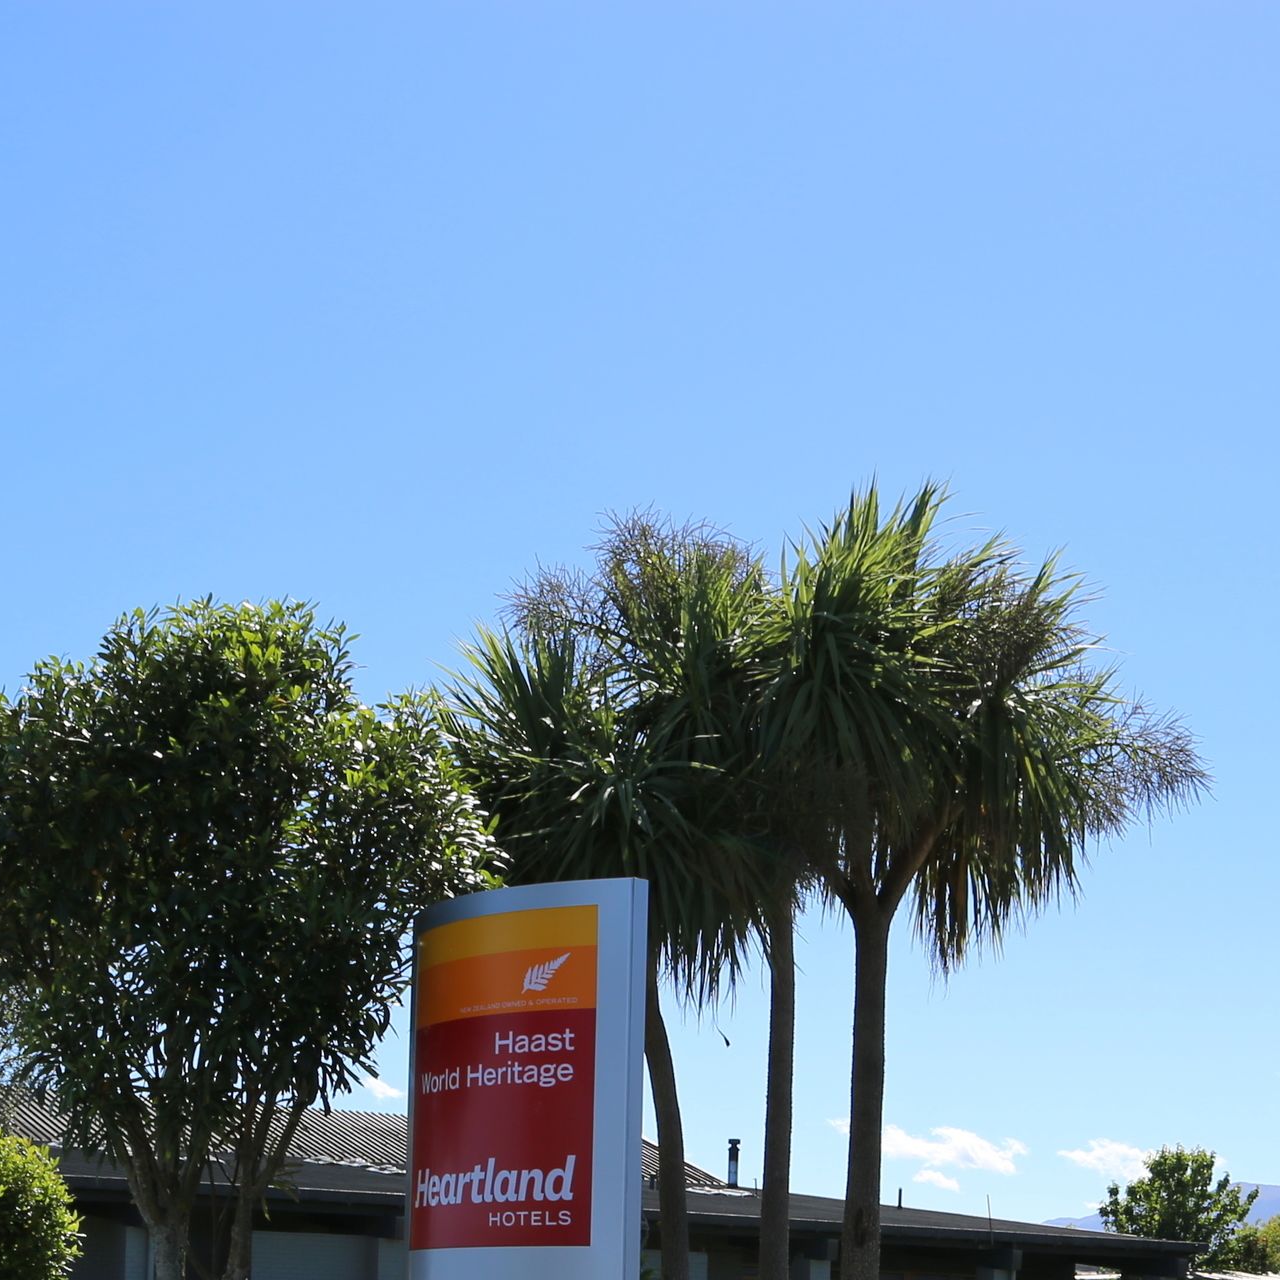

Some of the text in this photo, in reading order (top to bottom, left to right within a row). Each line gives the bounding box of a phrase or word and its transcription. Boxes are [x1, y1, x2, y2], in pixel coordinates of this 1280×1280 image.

[500, 999, 526, 1009] OWNED
[535, 996, 578, 1005] OPERATED
[495, 1027, 575, 1055] Haast
[421, 1060, 574, 1095] World Heritage
[414, 1154, 577, 1209] Heartland
[488, 1210, 572, 1227] HOTELS
